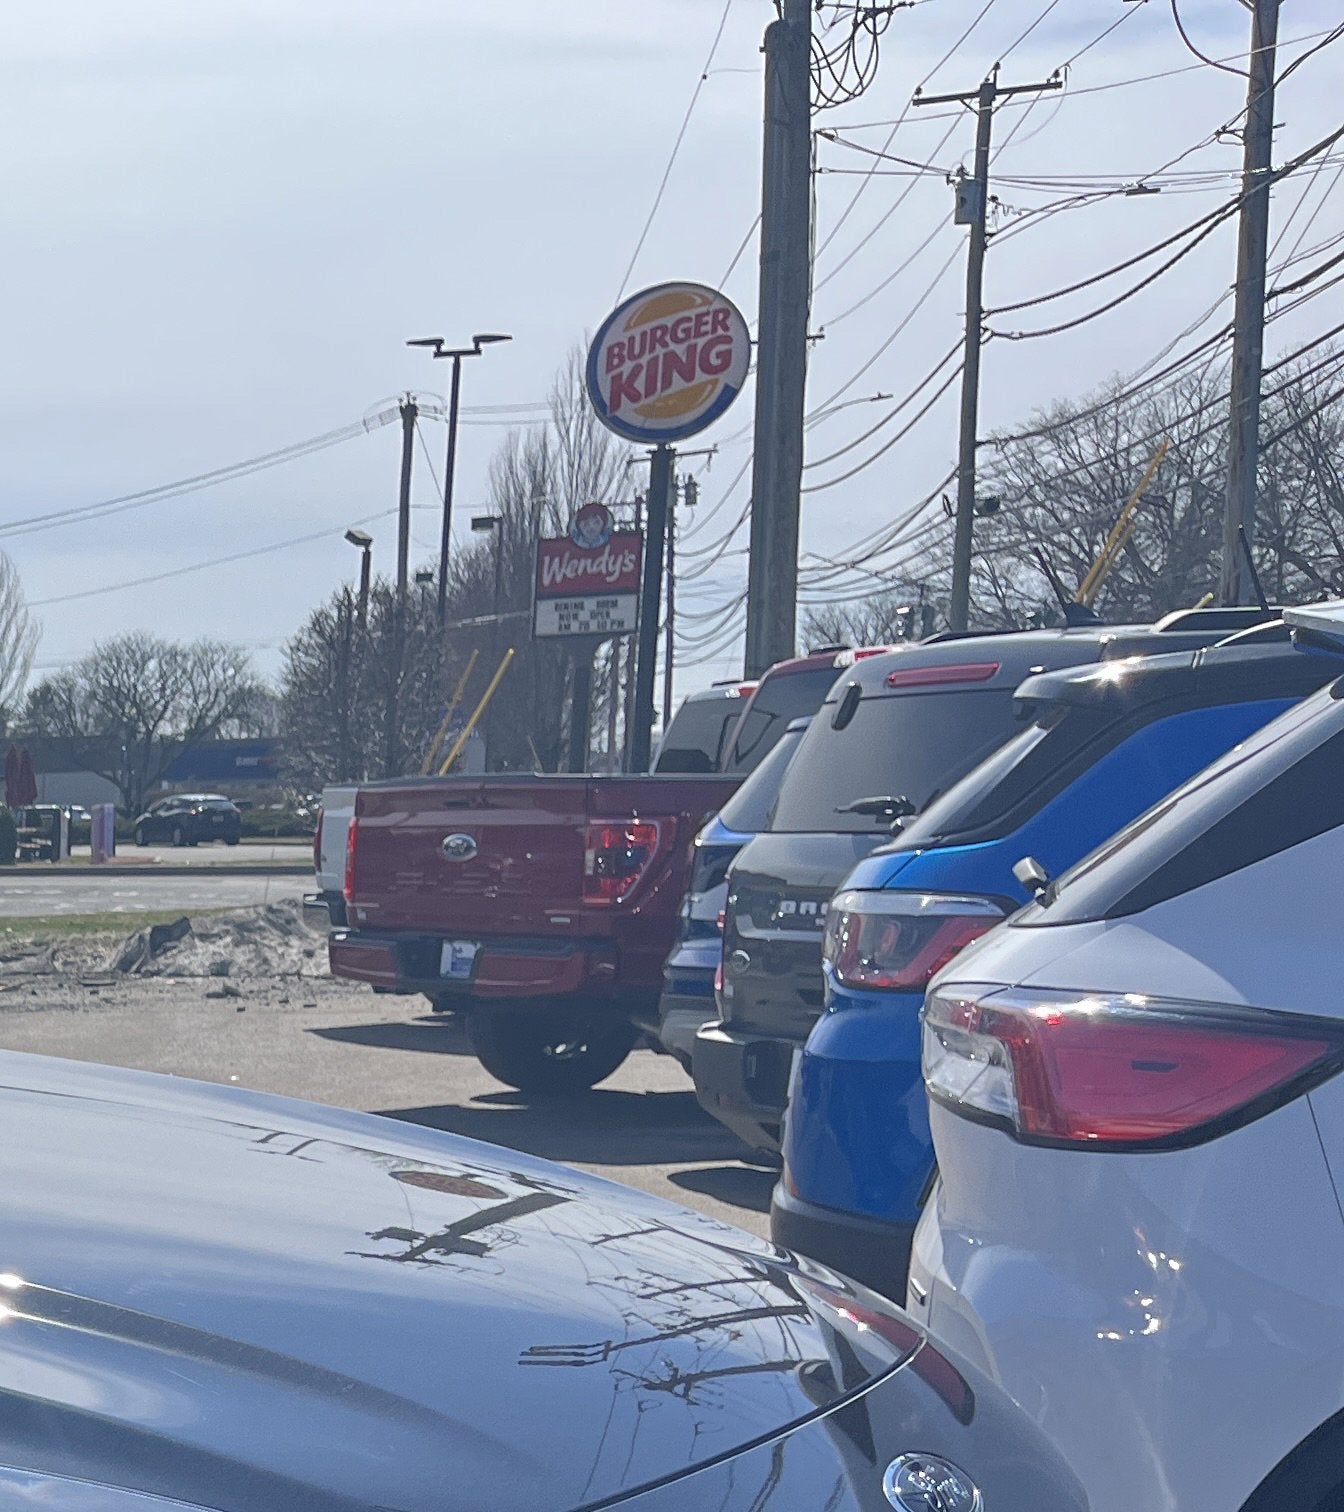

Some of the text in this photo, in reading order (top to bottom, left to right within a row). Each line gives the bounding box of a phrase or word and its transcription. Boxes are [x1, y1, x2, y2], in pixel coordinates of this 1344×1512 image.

[605, 307, 731, 375] BURGER
[608, 335, 734, 414] KING
[542, 544, 637, 587] Wendy's
